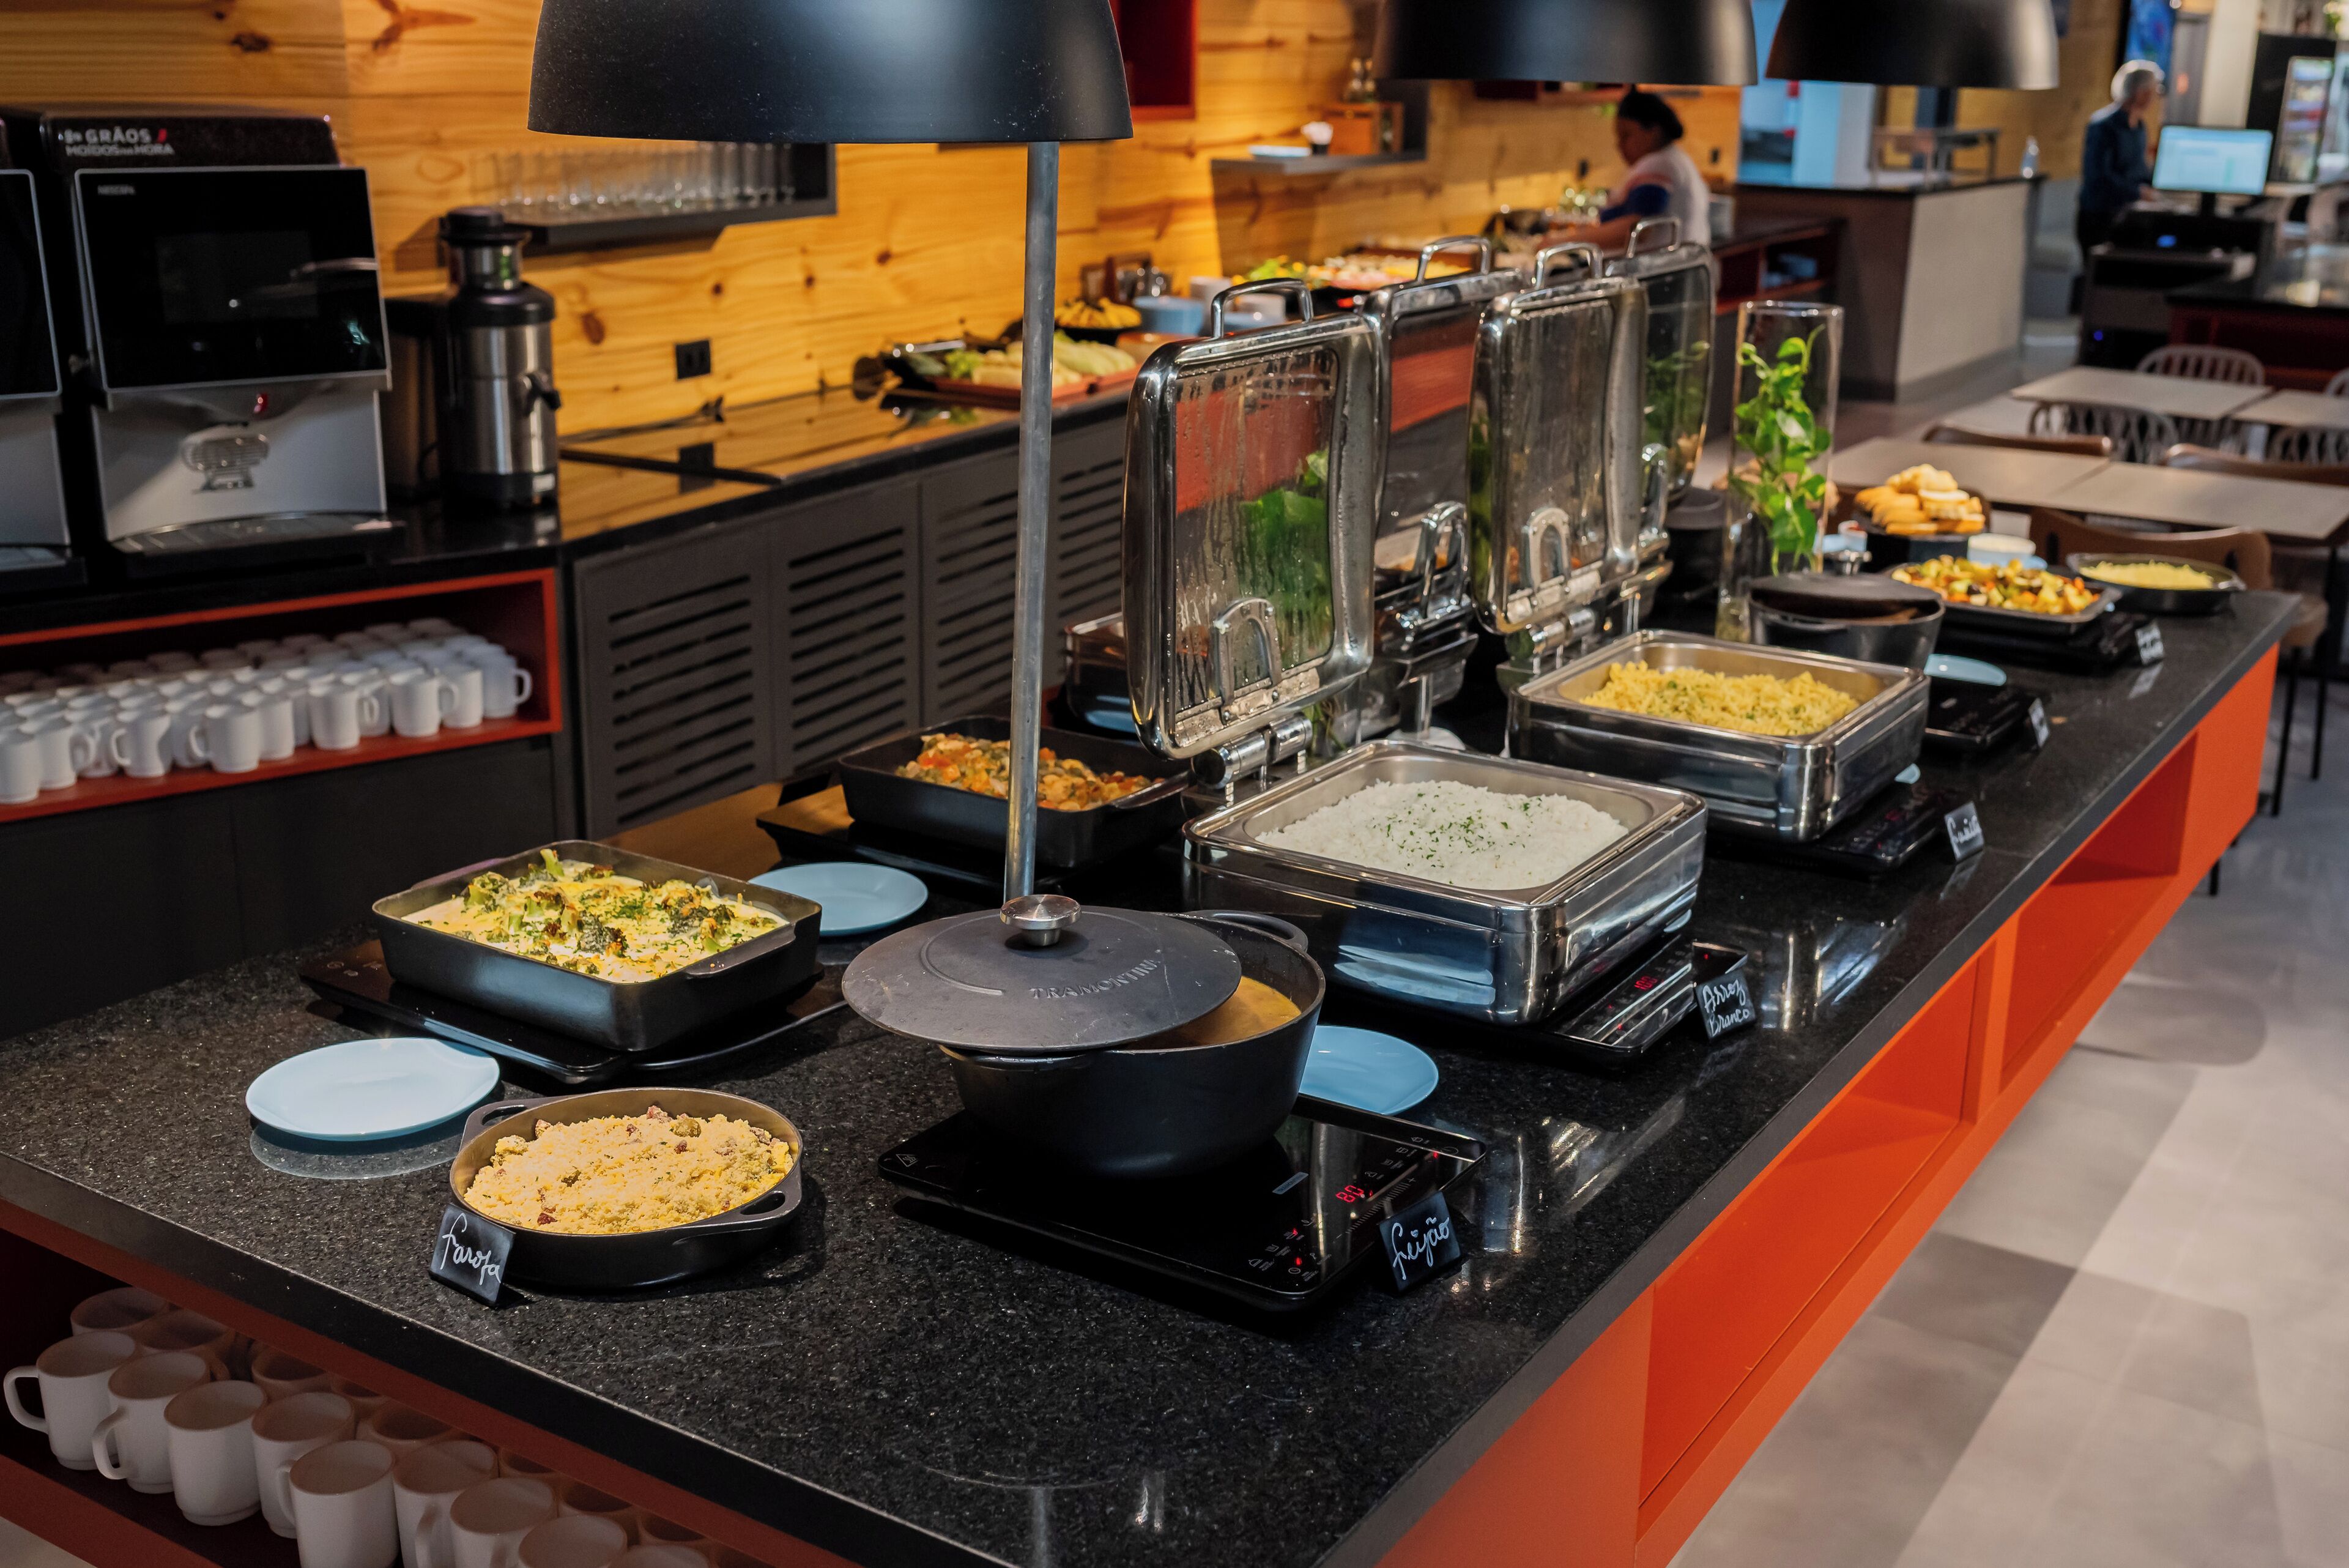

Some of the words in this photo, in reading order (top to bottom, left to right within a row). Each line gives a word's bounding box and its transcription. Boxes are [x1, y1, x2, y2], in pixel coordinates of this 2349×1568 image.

[85, 126, 152, 144] GRÃOS
[1702, 979, 1746, 1013] Arroz
[1708, 1009, 1750, 1037] Branco
[1335, 1185, 1364, 1203] 80
